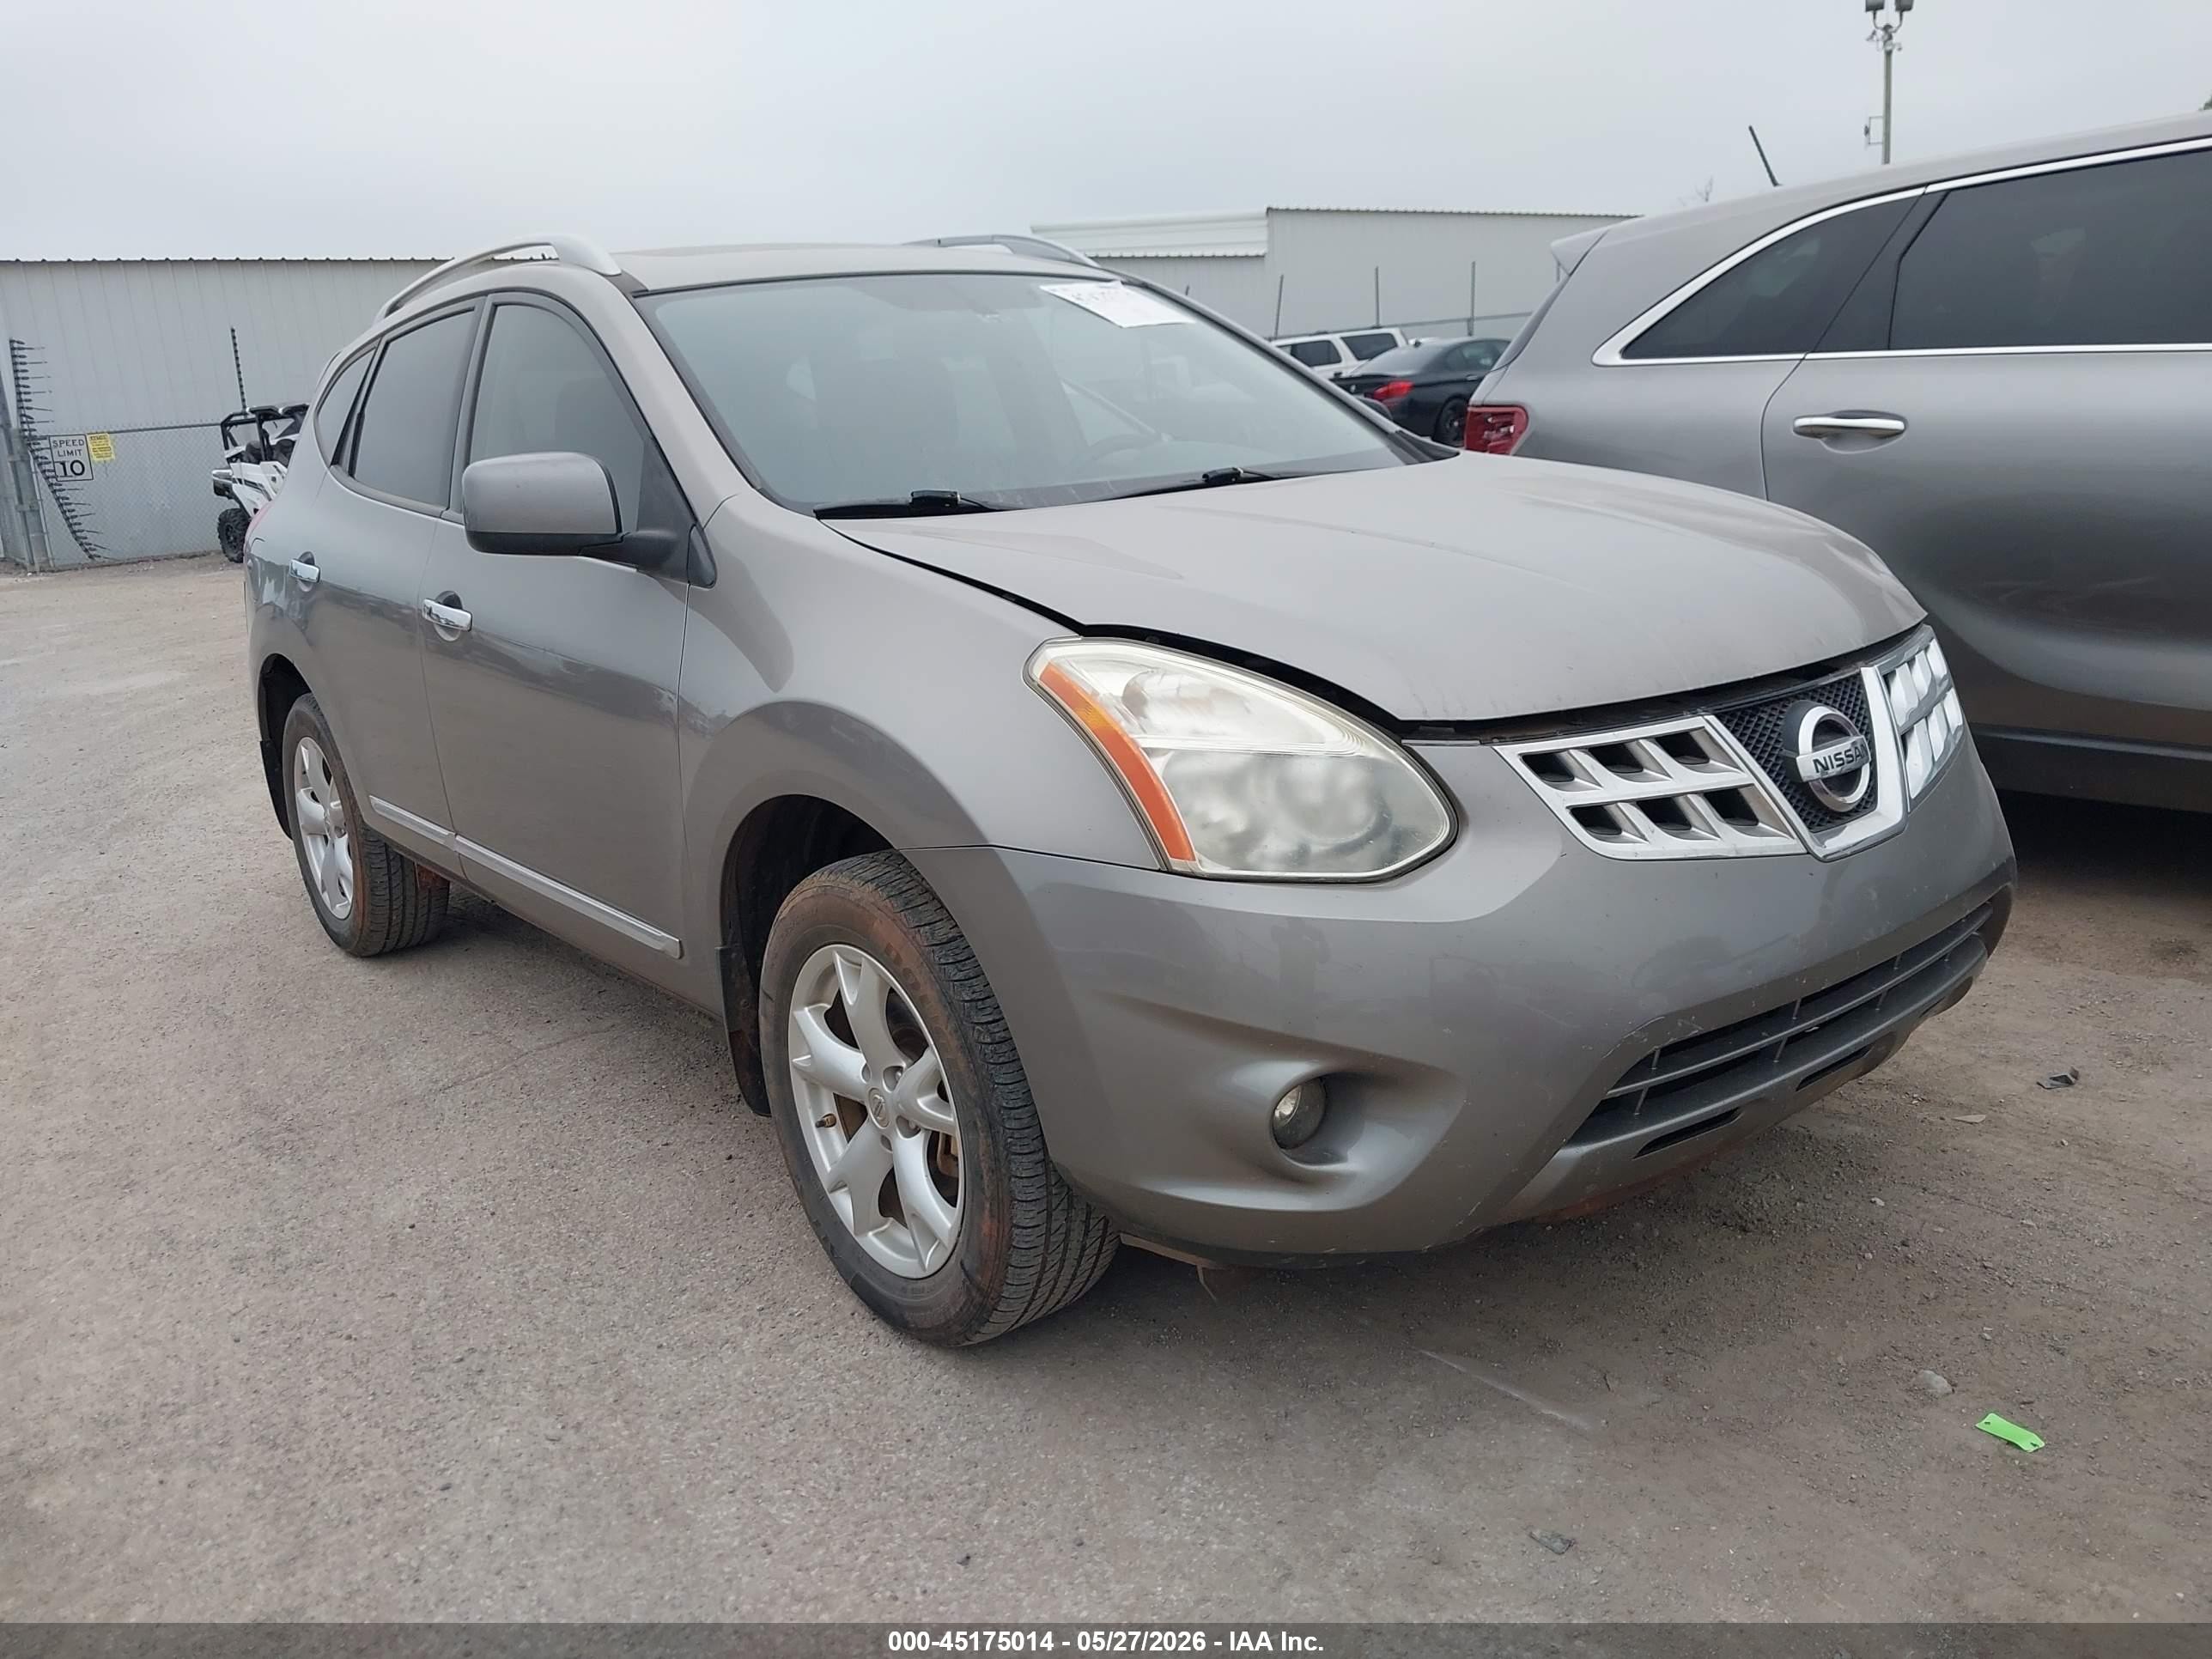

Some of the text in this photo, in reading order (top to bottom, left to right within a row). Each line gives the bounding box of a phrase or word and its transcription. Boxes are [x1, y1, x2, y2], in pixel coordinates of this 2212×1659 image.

[52, 439, 85, 448] SPEED
[58, 448, 82, 457] LIMIT
[58, 459, 85, 477] 10
[1812, 742, 1867, 774] NISSAN
